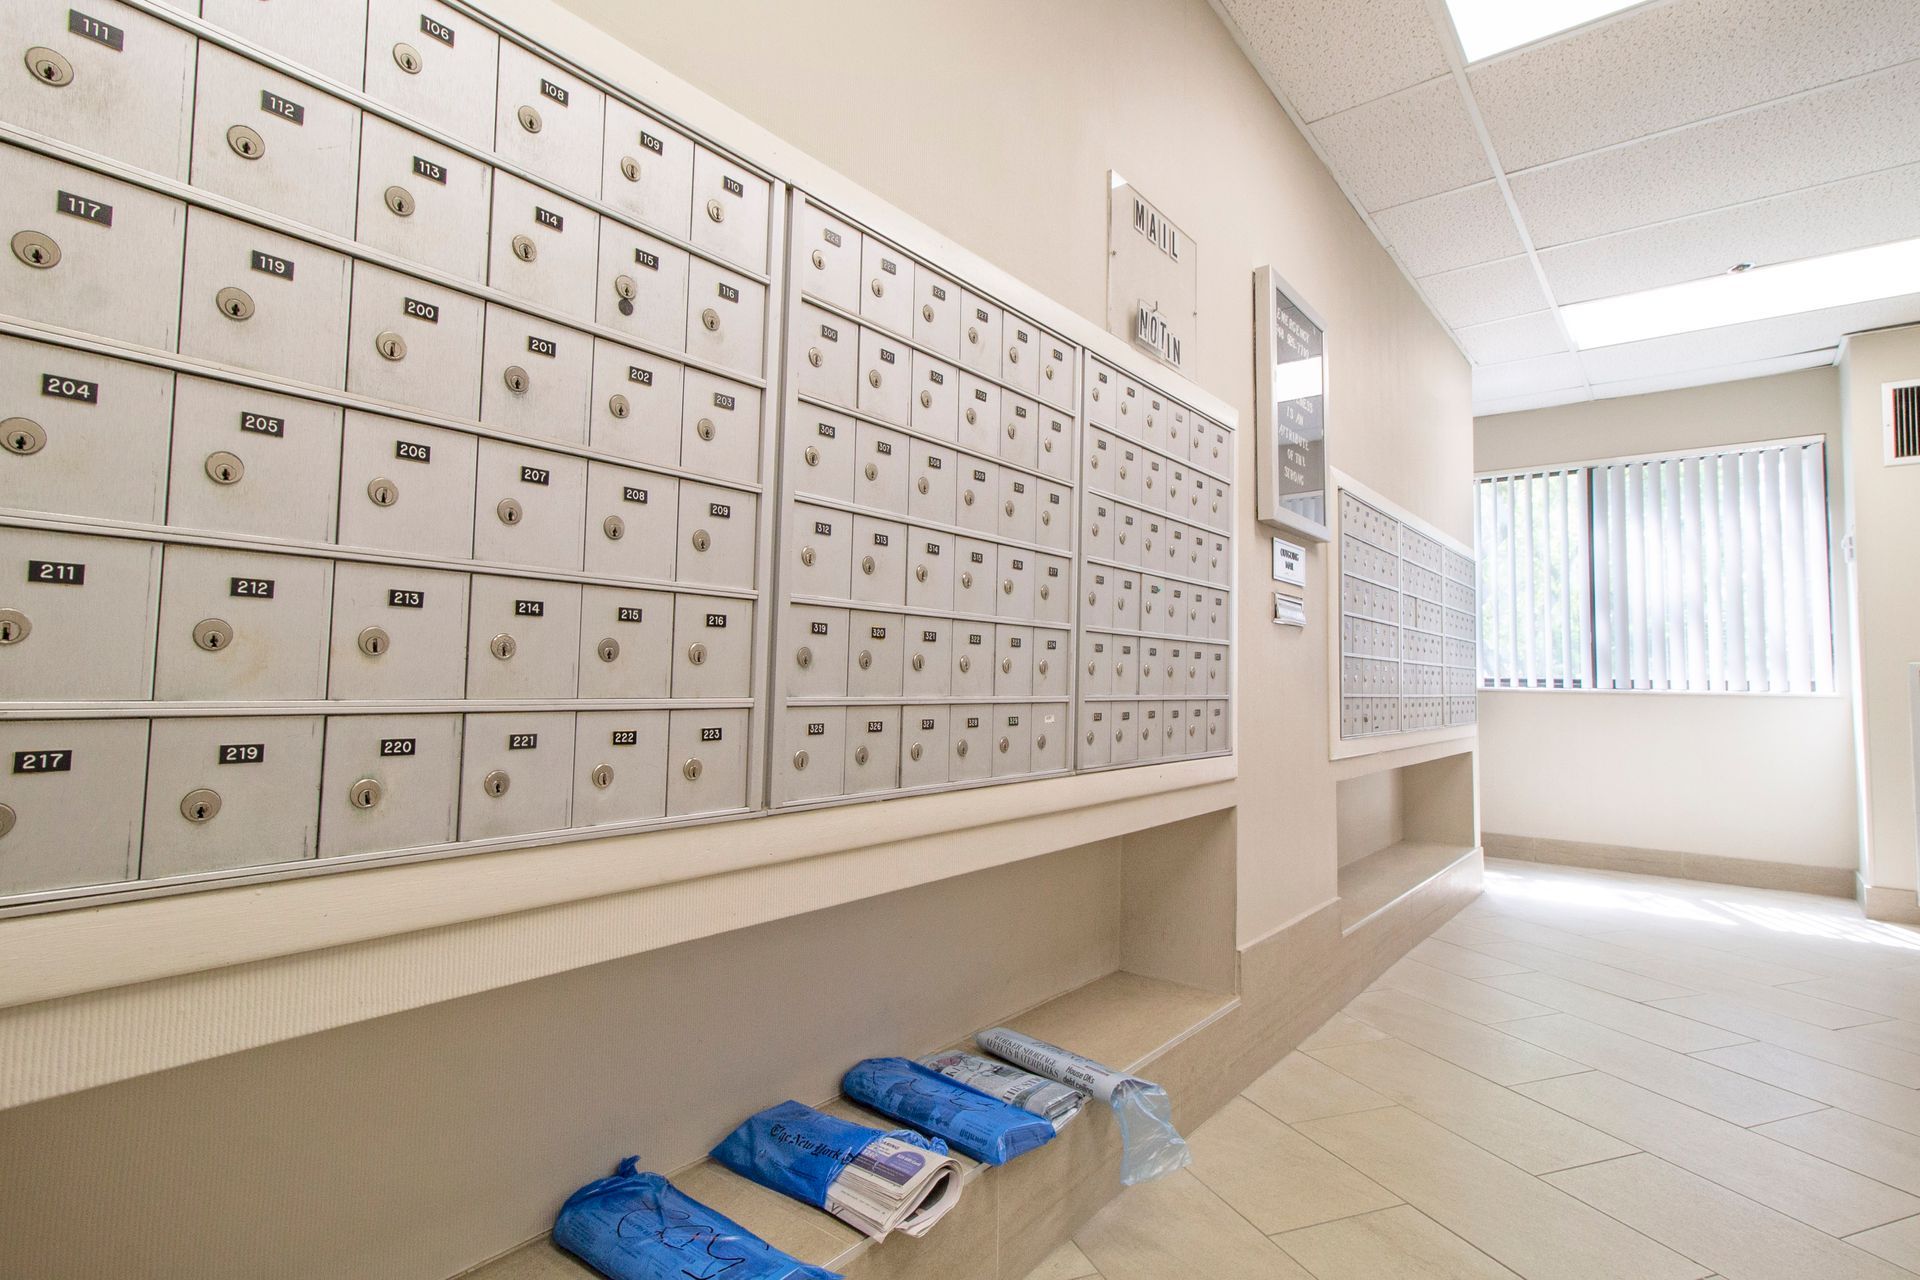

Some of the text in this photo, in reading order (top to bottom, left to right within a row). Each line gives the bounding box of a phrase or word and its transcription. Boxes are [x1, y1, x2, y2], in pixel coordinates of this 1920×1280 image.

[83, 18, 109, 41] 111
[425, 20, 449, 40] 106
[544, 82, 564, 101] 108
[270, 96, 295, 118] 112
[643, 134, 660, 151] 109
[419, 160, 440, 179] 113
[727, 179, 740, 193] 110
[68, 197, 101, 218] 117
[540, 210, 558, 226] 114
[1135, 200, 1179, 259] MAIL
[826, 230, 840, 245] 224
[260, 256, 285, 274] 119
[639, 252, 654, 266] 115
[722, 286, 735, 299] 116
[407, 301, 434, 319] 200
[823, 326, 837, 340] 300
[531, 339, 552, 354] 201
[882, 350, 894, 361] 301
[631, 368, 650, 383] 202
[932, 371, 943, 383] 302
[48, 378, 90, 399] 204
[716, 394, 733, 407] 203
[245, 415, 278, 433] 205
[820, 424, 834, 437] 306
[1278, 424, 1310, 451] ATTRIBUTE
[399, 443, 427, 459] 206
[878, 442, 891, 453] 307
[929, 457, 941, 468] 308
[524, 468, 547, 482] 207
[626, 488, 645, 501] 208
[712, 505, 729, 516] 209
[817, 523, 830, 534] 312
[875, 534, 888, 545] 313
[928, 544, 939, 554] 314
[40, 563, 74, 580] 211
[237, 580, 268, 595] 212
[394, 591, 420, 605] 213
[518, 602, 540, 614] 214
[621, 609, 639, 620] 215
[708, 615, 724, 626] 216
[813, 623, 827, 634] 319
[872, 628, 885, 638] 320
[925, 631, 936, 641] 321
[809, 724, 824, 734] 325
[869, 722, 882, 731] 326
[922, 719, 934, 729] 327
[513, 735, 534, 747] 221
[614, 732, 634, 743] 222
[703, 729, 720, 740] 223
[226, 746, 258, 761] 219
[384, 740, 412, 754] 220
[22, 753, 64, 770] 217
[986, 1038, 1013, 1058] AFFECTS
[1013, 1049, 1060, 1078] WATERPARKS
[994, 1035, 1023, 1053] WORKER
[1021, 1046, 1057, 1067] SHORTAGE
[1065, 1065, 1085, 1079] House
[770, 1124, 843, 1159] The New York
